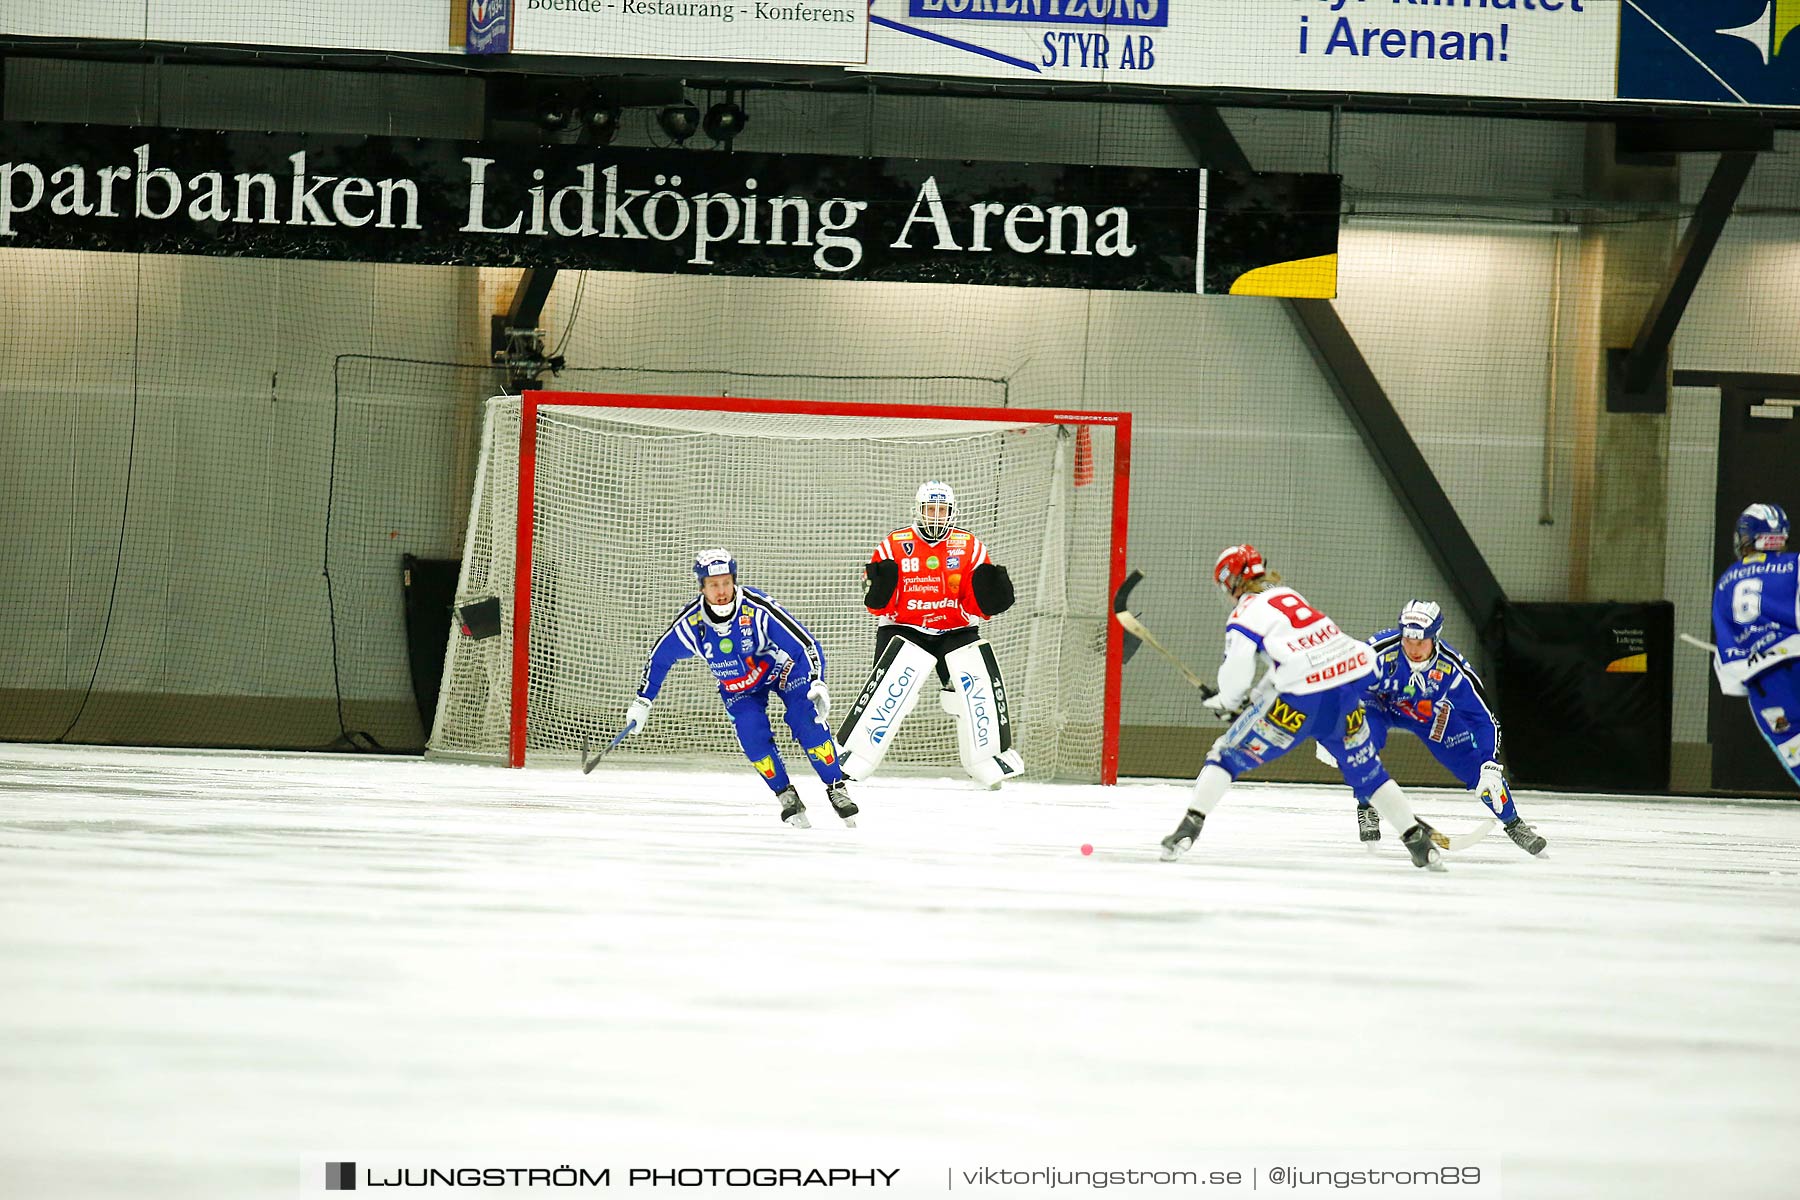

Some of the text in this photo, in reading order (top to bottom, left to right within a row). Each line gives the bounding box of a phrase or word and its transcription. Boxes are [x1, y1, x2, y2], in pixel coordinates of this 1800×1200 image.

[622, 0, 734, 22] Restaurang
[754, 2, 855, 23] Konferens
[1041, 31, 1156, 71] STYR AB
[1299, 15, 1509, 62] i Arenan!
[458, 156, 869, 272] Lidköping
[889, 175, 1138, 258] Arena
[900, 557, 920, 573] 88
[906, 597, 959, 611] Stavdal
[1267, 593, 1327, 629] 8
[1732, 577, 1763, 626] 6
[703, 642, 714, 659] 2
[726, 665, 763, 691] avdal
[853, 666, 886, 717] 1934
[871, 665, 916, 722] ViaCon
[972, 687, 990, 748] ViaCon
[992, 677, 1009, 726] 1934
[1272, 697, 1307, 730] YVS
